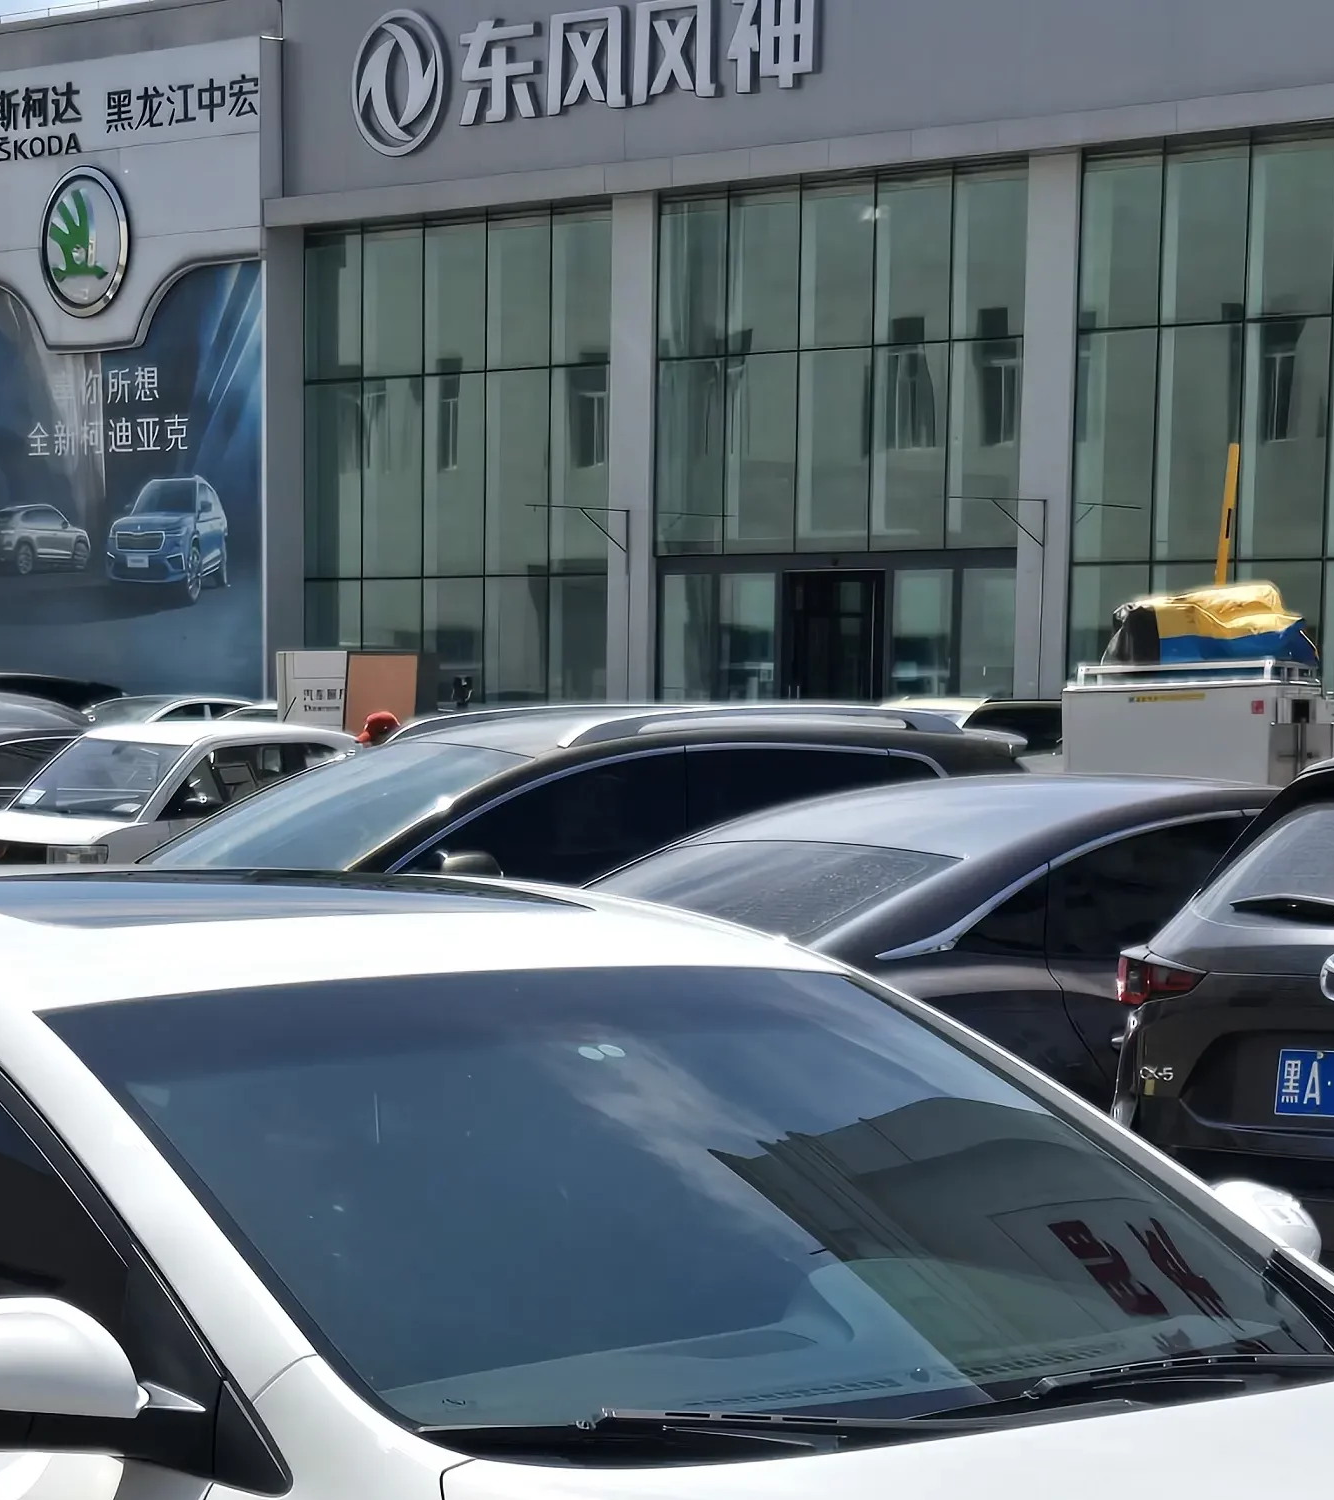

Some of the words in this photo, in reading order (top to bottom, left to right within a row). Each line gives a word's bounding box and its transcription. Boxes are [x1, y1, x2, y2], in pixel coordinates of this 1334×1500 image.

[459, 0, 817, 126] 东风风神
[106, 74, 259, 134] 黑龙江中宏
[27, 414, 190, 457] 全新柯迪亚克
[1139, 1065, 1174, 1082] CX-5
